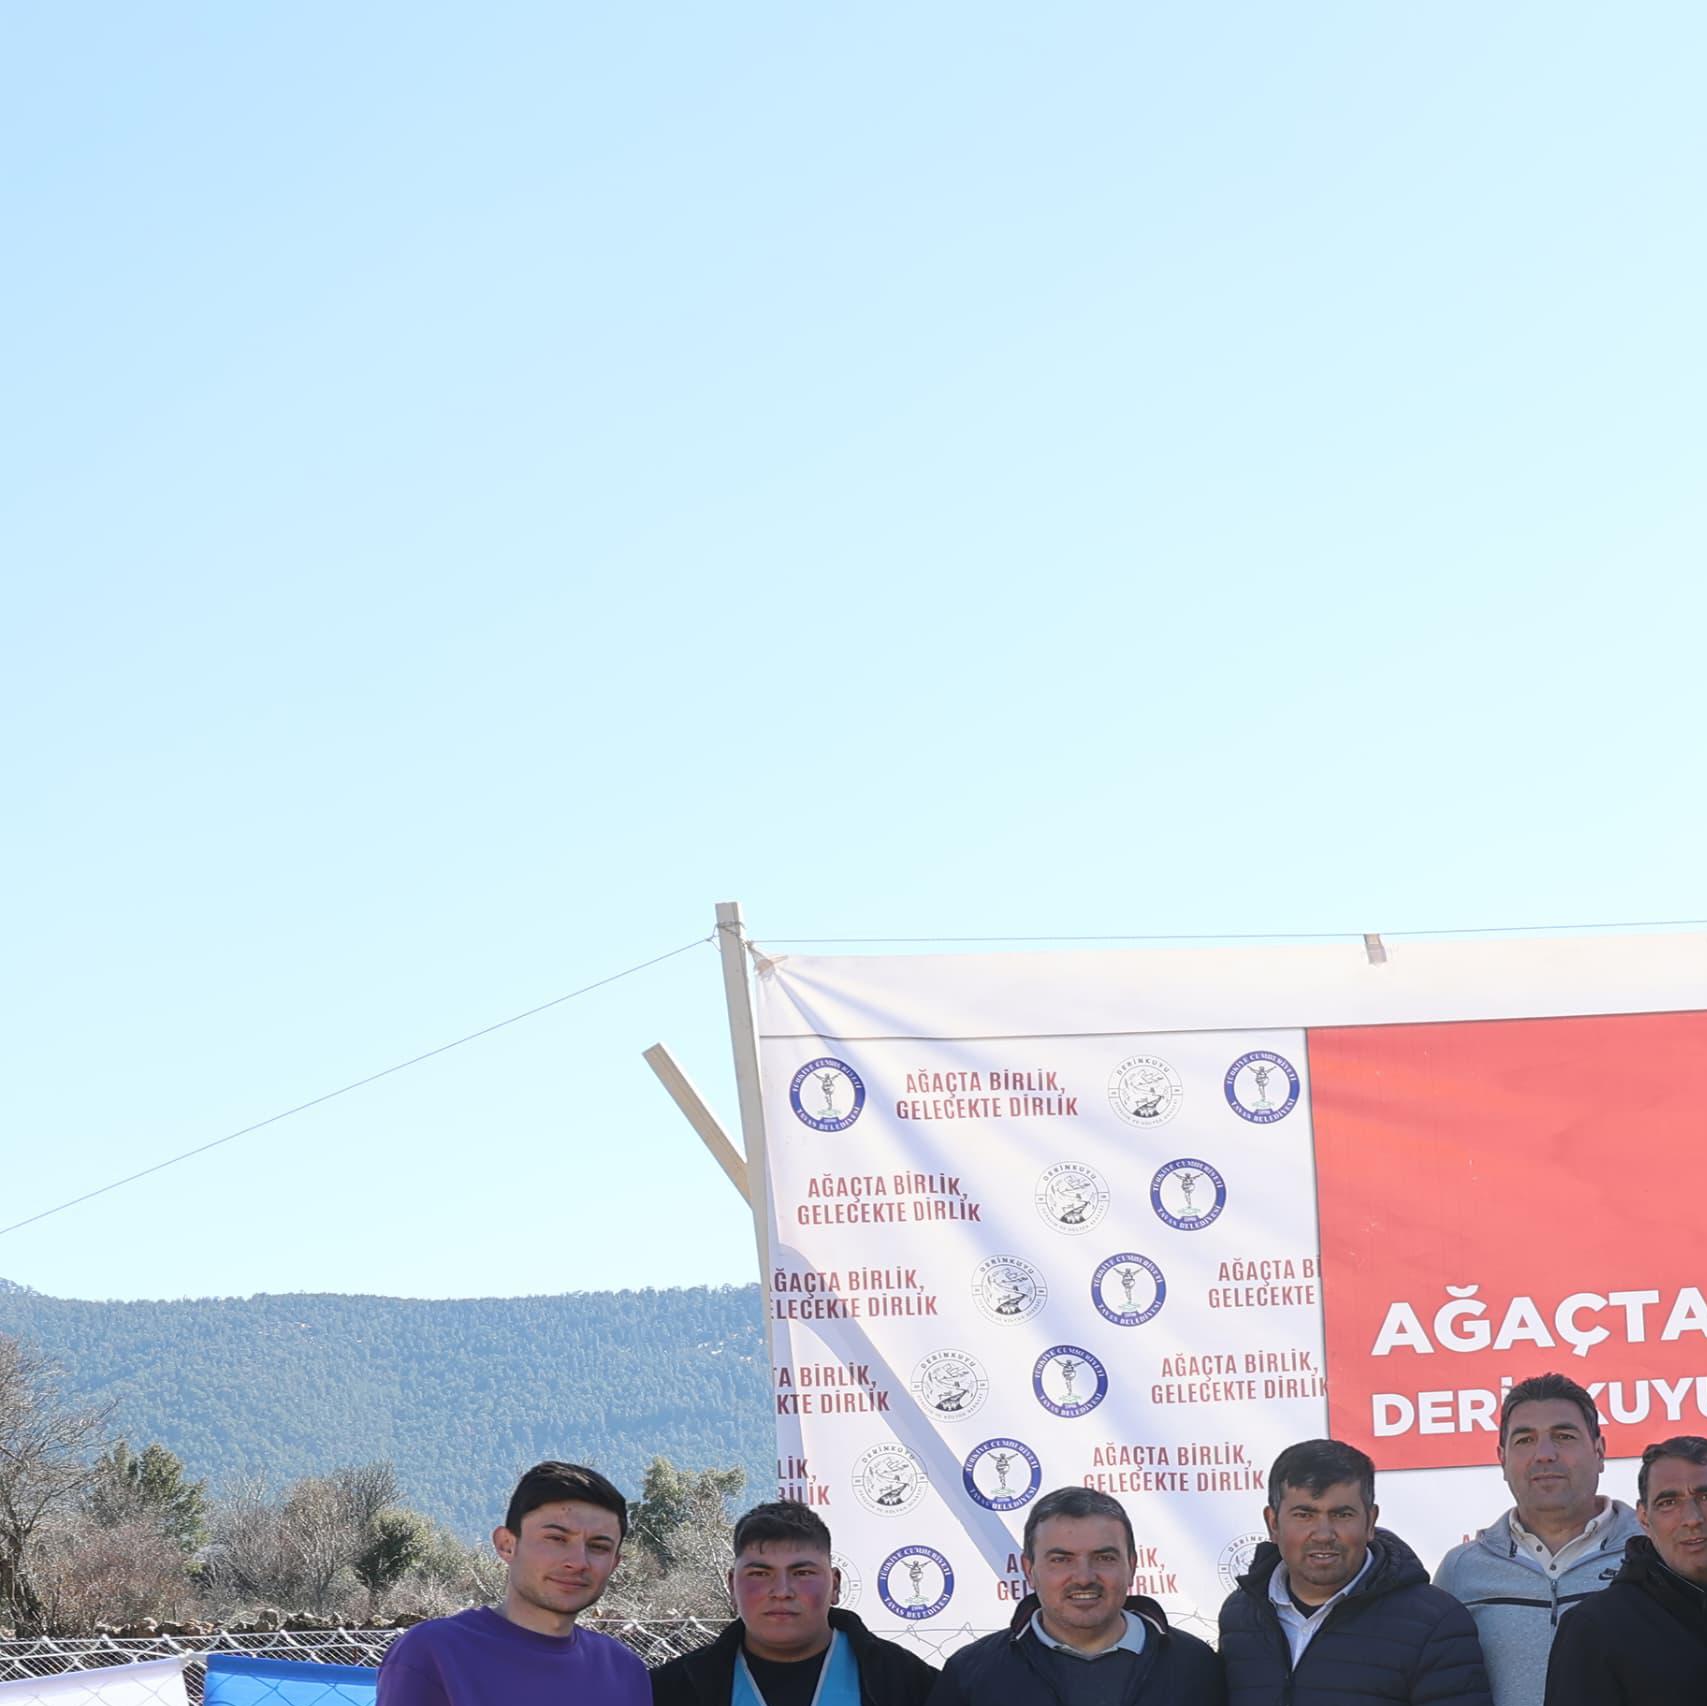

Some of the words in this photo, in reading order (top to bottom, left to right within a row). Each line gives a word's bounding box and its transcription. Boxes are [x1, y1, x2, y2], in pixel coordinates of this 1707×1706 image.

[906, 1067, 981, 1099] AĞAÇTA
[989, 1069, 1066, 1093] BİRLİK,
[896, 1097, 1002, 1120] GELECEKTE
[1009, 1091, 1079, 1117] DİRLİK
[808, 1172, 887, 1202] AĞAÇTA
[892, 1172, 968, 1198] BİRLİK,
[797, 1202, 906, 1225] GELECEKTE
[913, 1198, 981, 1222] DİRLİK
[848, 1266, 925, 1292] BİRLİK,
[1218, 1257, 1295, 1287] AĞAÇTA
[771, 1298, 861, 1320] LECEKTE
[868, 1292, 938, 1317] DİRLİK
[1208, 1285, 1315, 1308] GELECEKTE
[799, 1362, 877, 1388] BİRLİK,
[1161, 1352, 1237, 1382] AĞAÇTA
[1245, 1348, 1319, 1375] BİRLİK,
[820, 1389, 890, 1414] DİRLİK
[1151, 1380, 1257, 1405] GELECEKTE
[777, 1456, 816, 1482] LİK,
[1092, 1442, 1171, 1471] AĞAÇTA
[1177, 1441, 1253, 1468] BİRLİK,
[1083, 1470, 1191, 1495] GELECEKTE
[1196, 1466, 1265, 1492] DİRLİK
